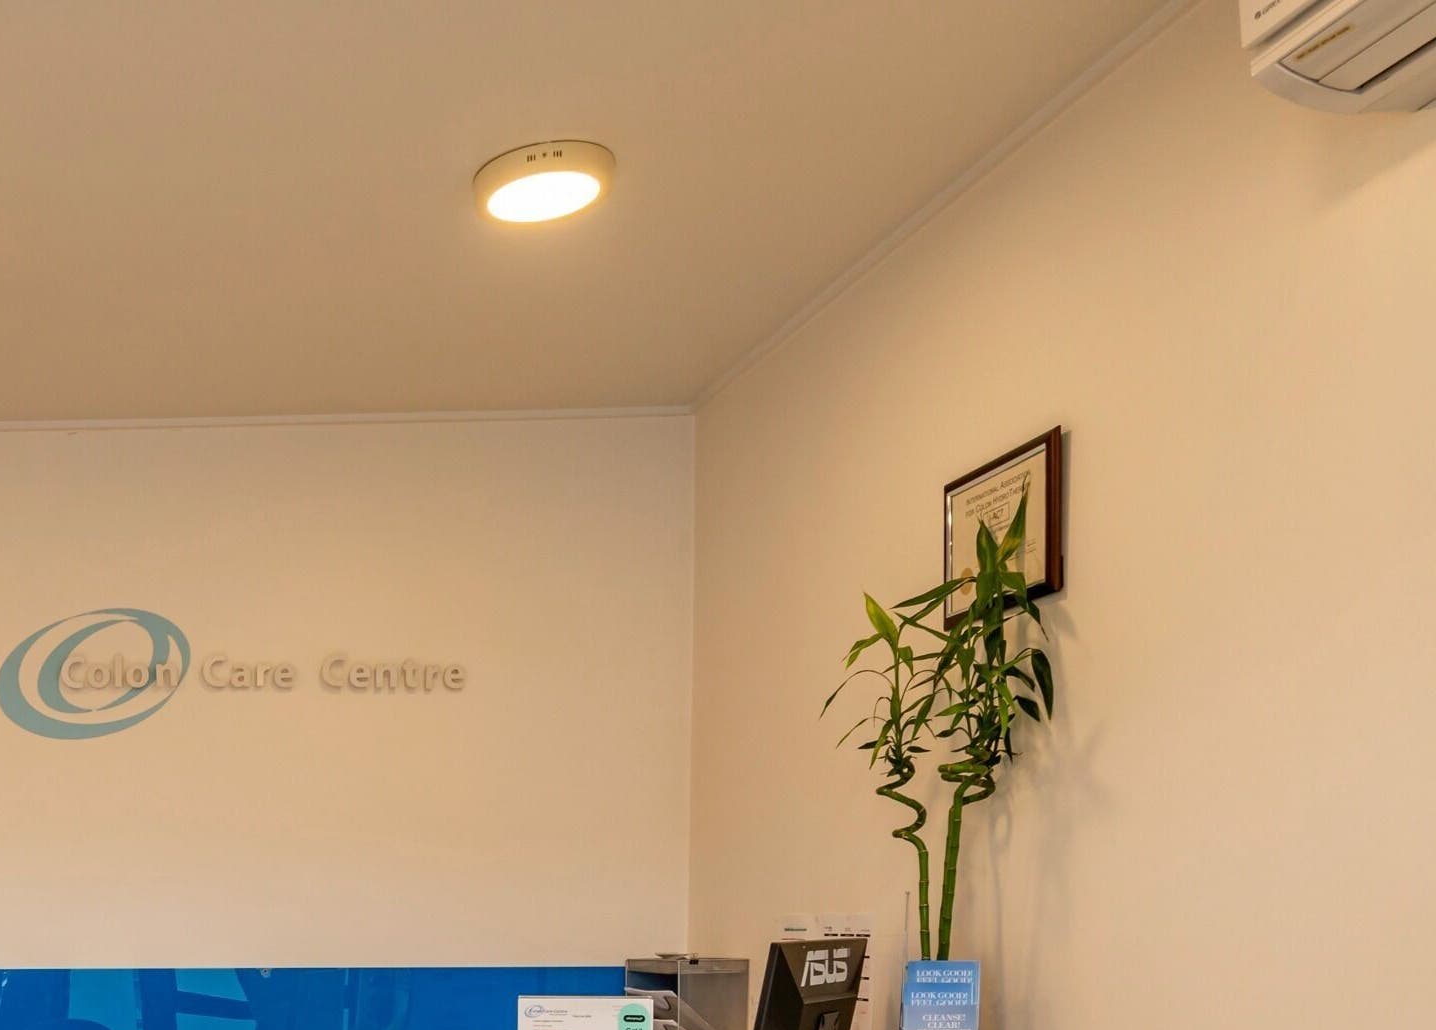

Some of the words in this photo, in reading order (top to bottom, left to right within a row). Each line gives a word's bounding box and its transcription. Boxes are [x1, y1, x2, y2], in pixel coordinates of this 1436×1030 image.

[61, 654, 180, 690] Colon
[200, 654, 294, 690] Care
[319, 654, 465, 690] Centre
[801, 948, 851, 987] ASUS
